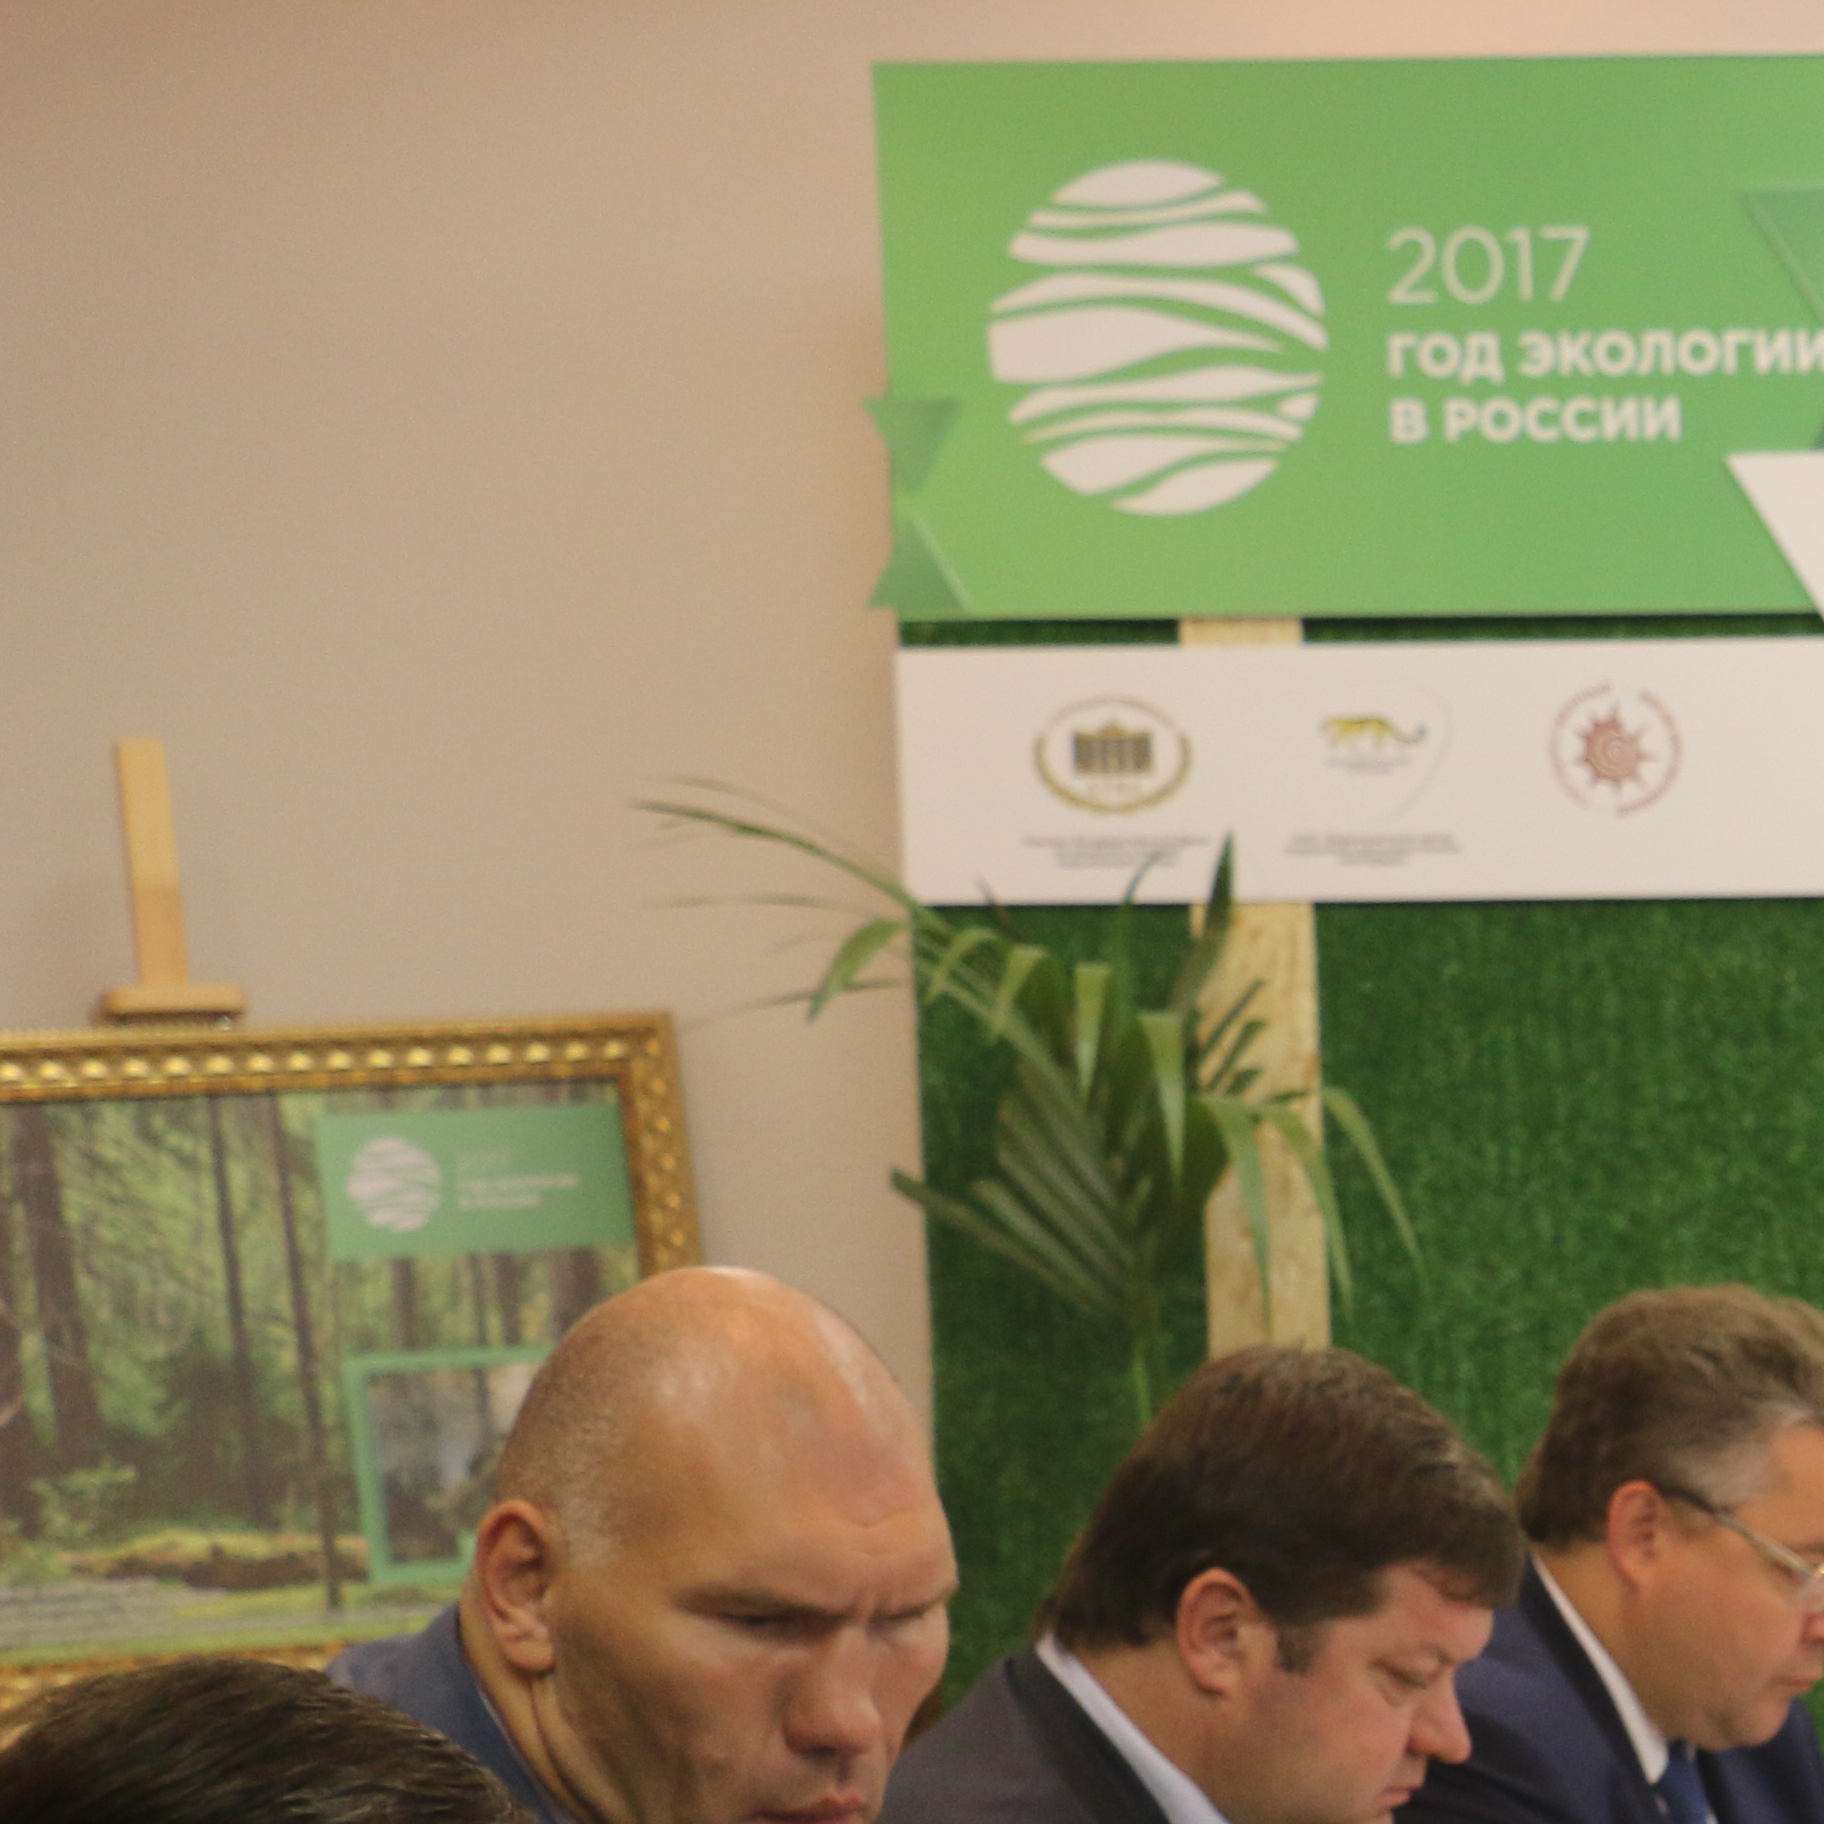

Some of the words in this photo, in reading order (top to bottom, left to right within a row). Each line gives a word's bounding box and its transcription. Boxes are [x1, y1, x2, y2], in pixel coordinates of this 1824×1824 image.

[1387, 224, 1590, 304] 2017
[1387, 331, 1504, 385] ГОД
[1389, 397, 1428, 443] В
[1443, 395, 1682, 444] РОССИИ
